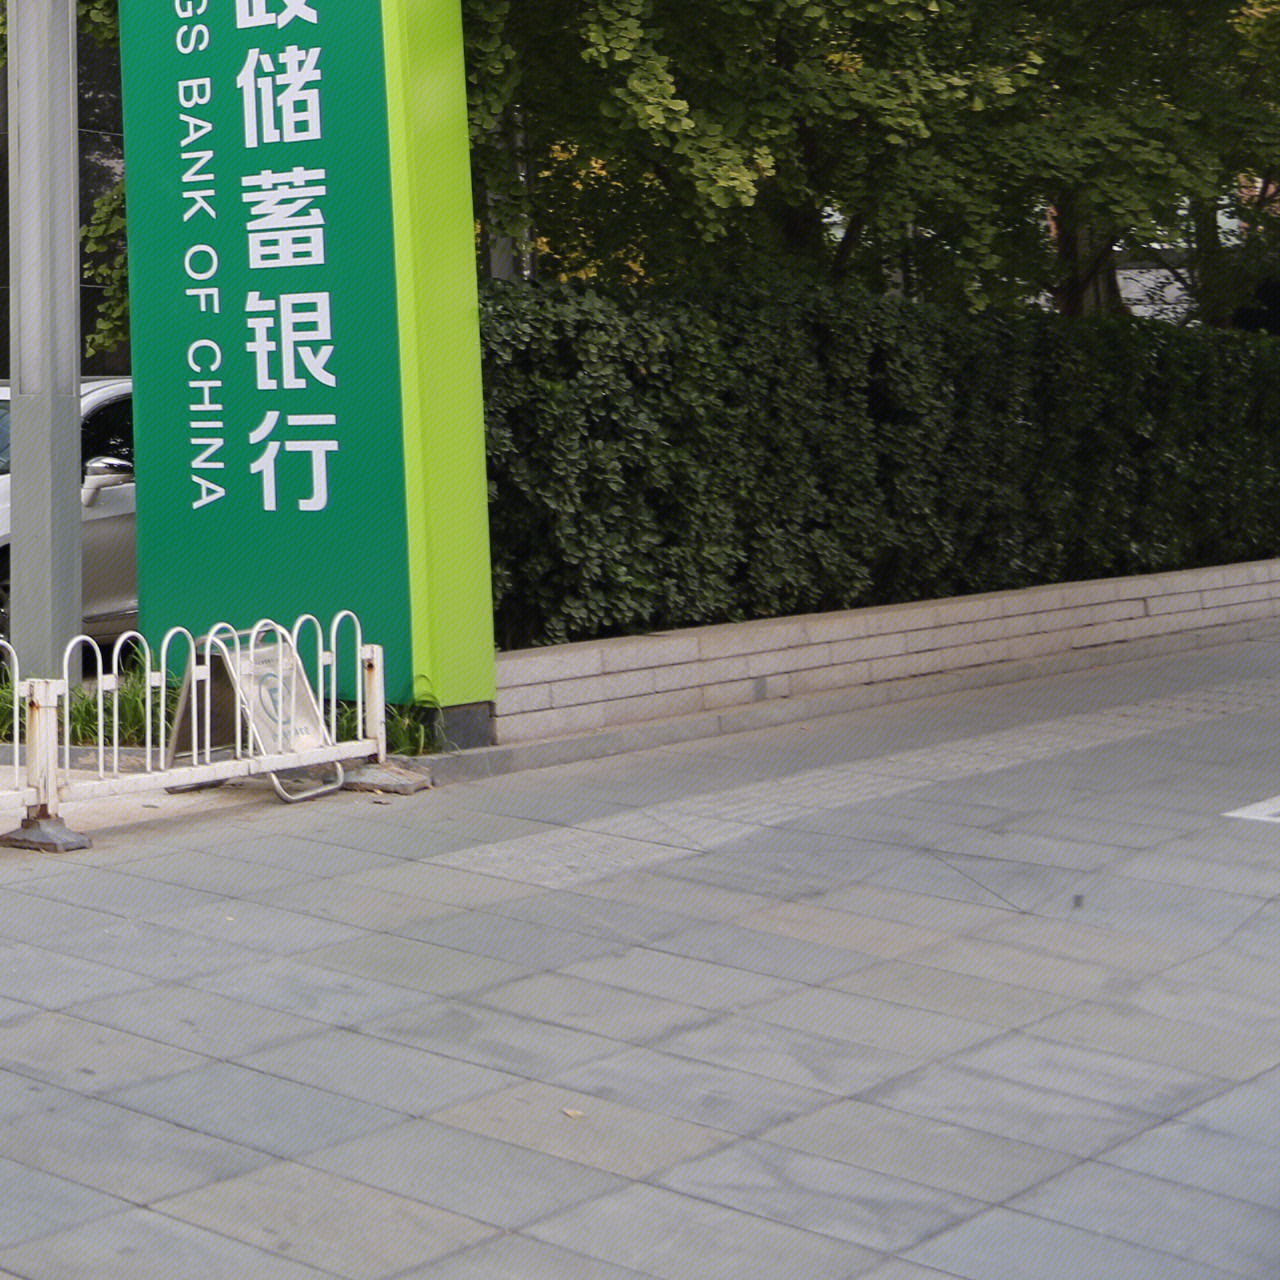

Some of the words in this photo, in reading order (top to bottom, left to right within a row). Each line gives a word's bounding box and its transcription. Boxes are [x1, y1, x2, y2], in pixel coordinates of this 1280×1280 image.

[177, 76, 217, 223] BANK
[184, 244, 221, 314] OF
[187, 338, 226, 510] CHINA
